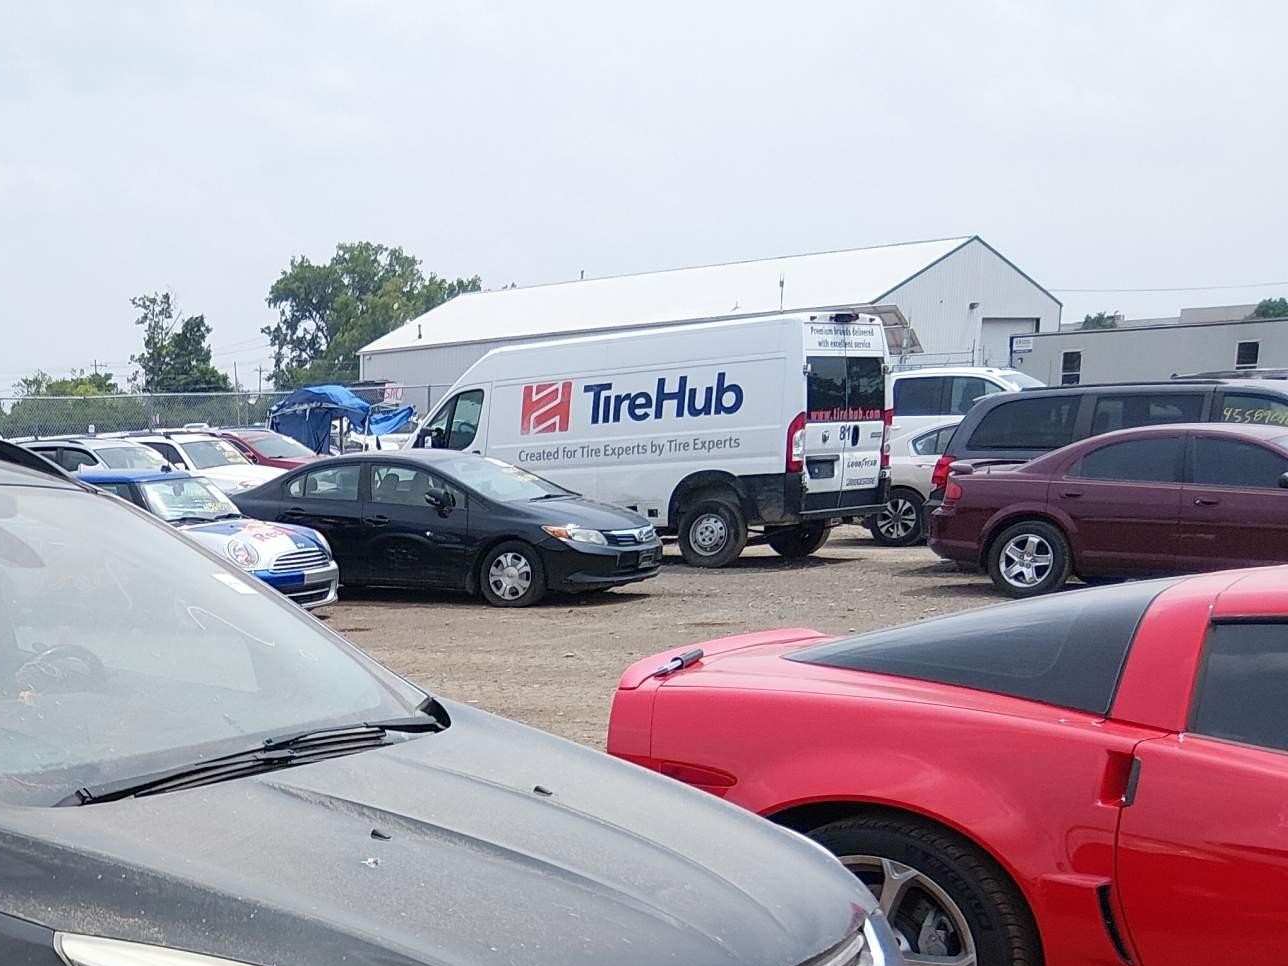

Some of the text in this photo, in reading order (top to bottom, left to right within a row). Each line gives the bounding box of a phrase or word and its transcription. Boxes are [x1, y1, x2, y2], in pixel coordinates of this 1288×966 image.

[810, 326, 874, 336] Premium brands delivered
[818, 339, 871, 348] with excellent service
[583, 372, 744, 425] TireHub
[810, 407, 881, 420] www.tirehub.com
[518, 436, 741, 462] Created for Tire Experts by Tire Experts
